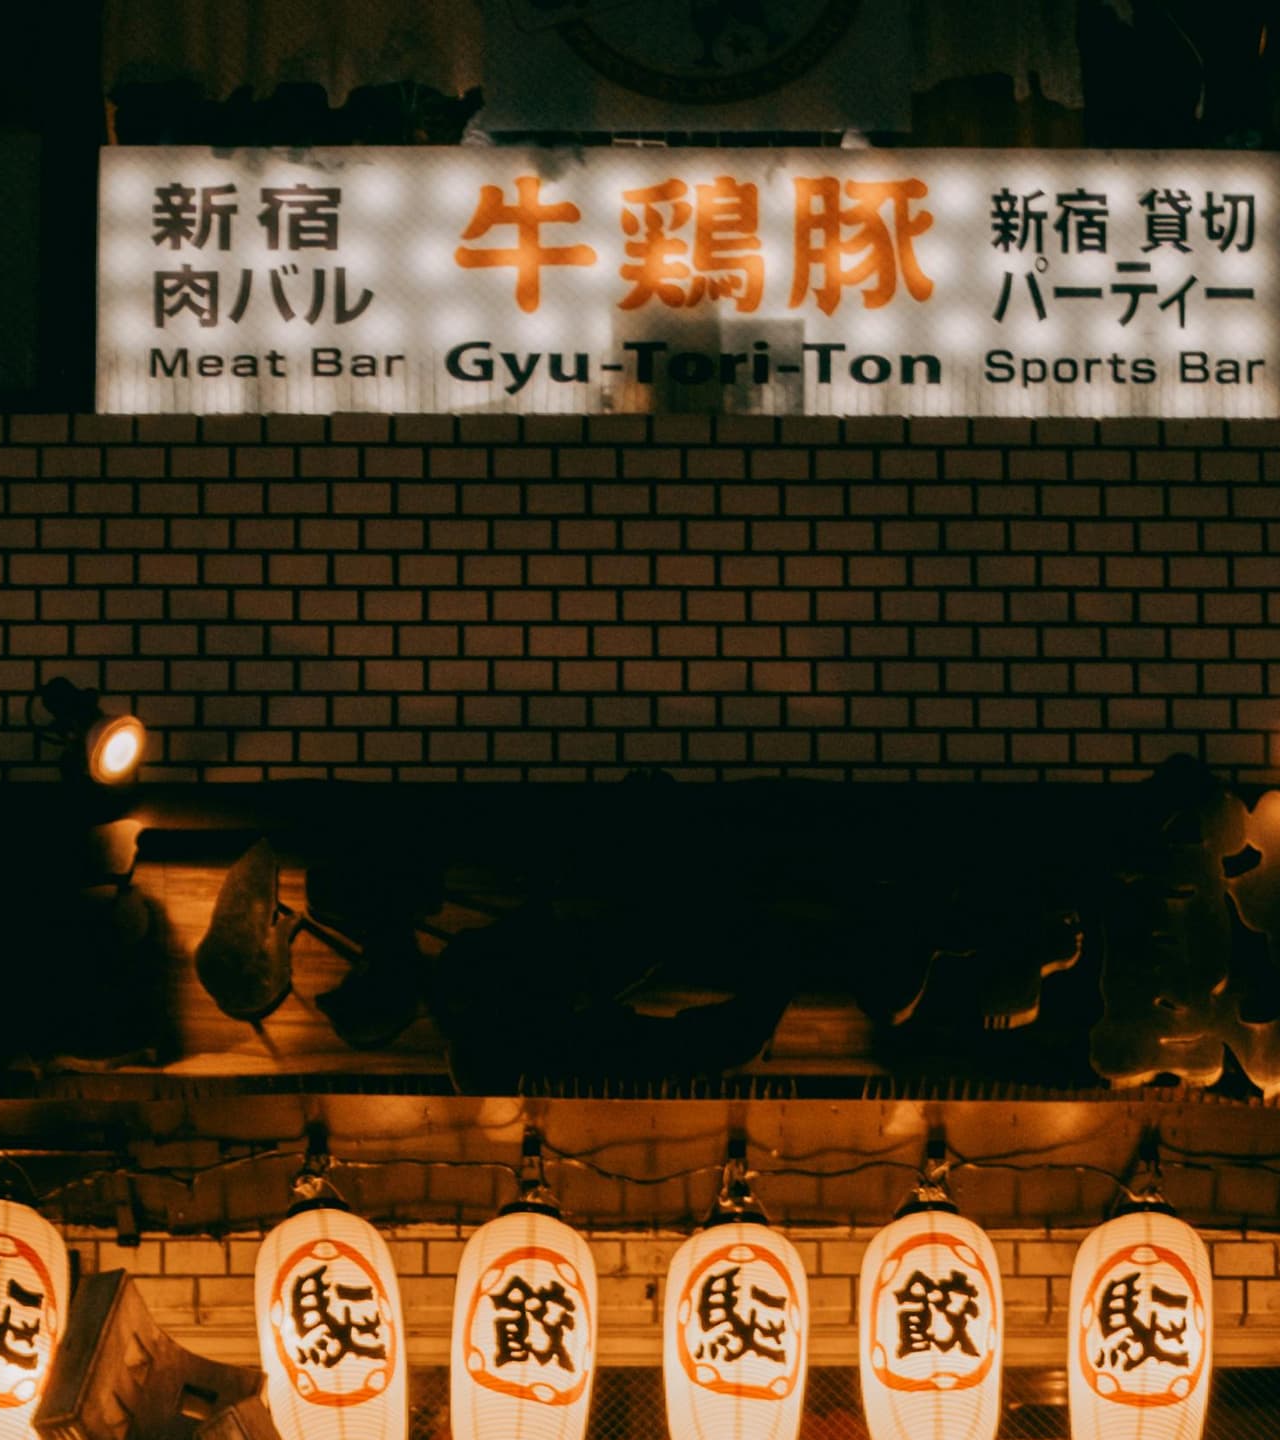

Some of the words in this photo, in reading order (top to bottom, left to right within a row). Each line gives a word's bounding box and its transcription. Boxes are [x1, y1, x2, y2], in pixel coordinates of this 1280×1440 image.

[151, 184, 343, 252] 新宿
[454, 175, 935, 314] 牛鶏豚
[991, 190, 1108, 254] 新宿
[1141, 190, 1256, 253] 貸切
[151, 264, 374, 328] 肉バル
[991, 258, 1256, 328] パーティー
[150, 348, 287, 378] Meat
[311, 348, 406, 378] Bar
[444, 342, 942, 391] Gyu-Tori-Ton
[985, 349, 1156, 391] Sports
[1179, 349, 1266, 382] Bar
